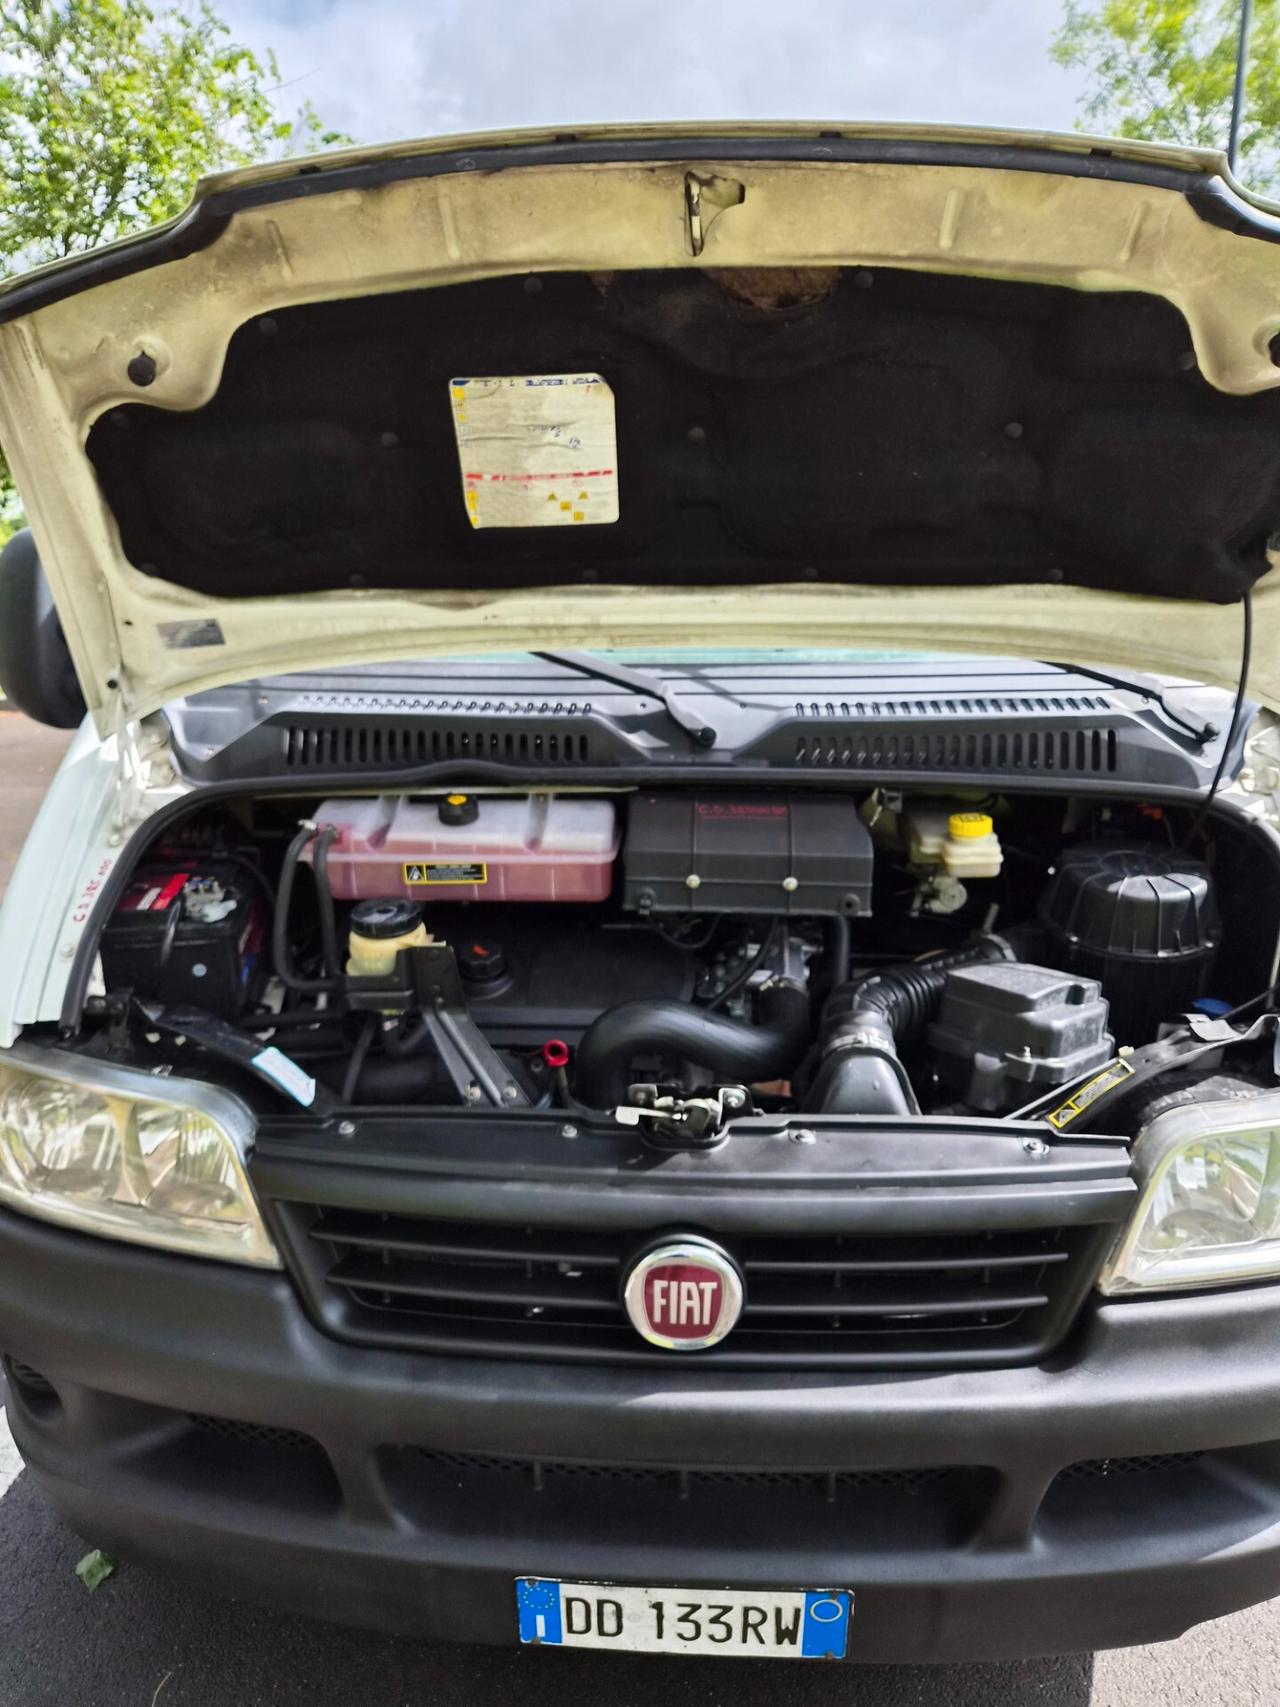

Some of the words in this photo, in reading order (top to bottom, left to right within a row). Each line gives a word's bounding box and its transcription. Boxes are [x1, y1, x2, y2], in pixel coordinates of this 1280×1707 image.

[653, 1280, 718, 1325] FIAT
[536, 1614, 546, 1637] I
[565, 1597, 624, 1638] DD
[649, 1601, 801, 1646] 133RW
